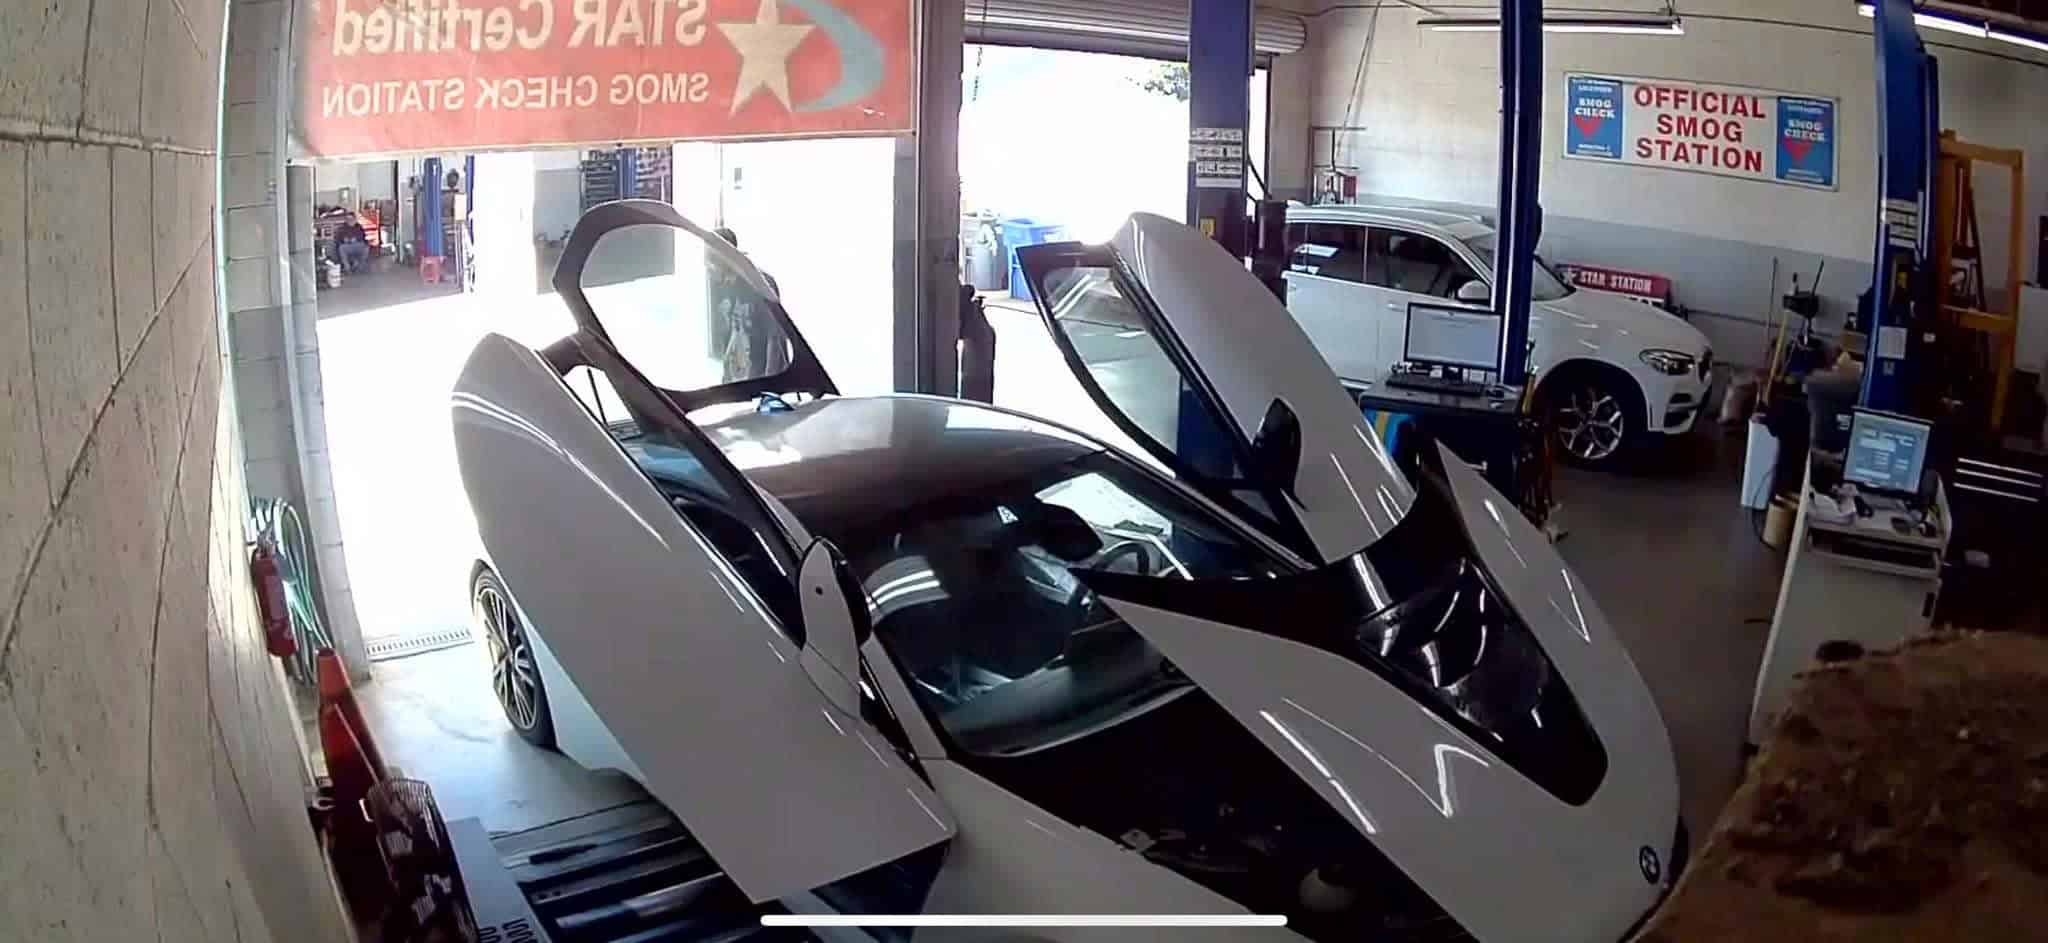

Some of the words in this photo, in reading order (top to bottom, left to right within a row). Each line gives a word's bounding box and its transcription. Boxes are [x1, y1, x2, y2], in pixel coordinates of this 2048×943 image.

[1574, 107, 1615, 118] CHECK
[1633, 86, 1767, 119] OFFICIAL
[1656, 113, 1744, 143] SMOG
[1783, 128, 1825, 141] CHECK
[1636, 137, 1763, 172] STATION
[1580, 271, 1606, 287] STAR
[1610, 275, 1652, 294] STATION
